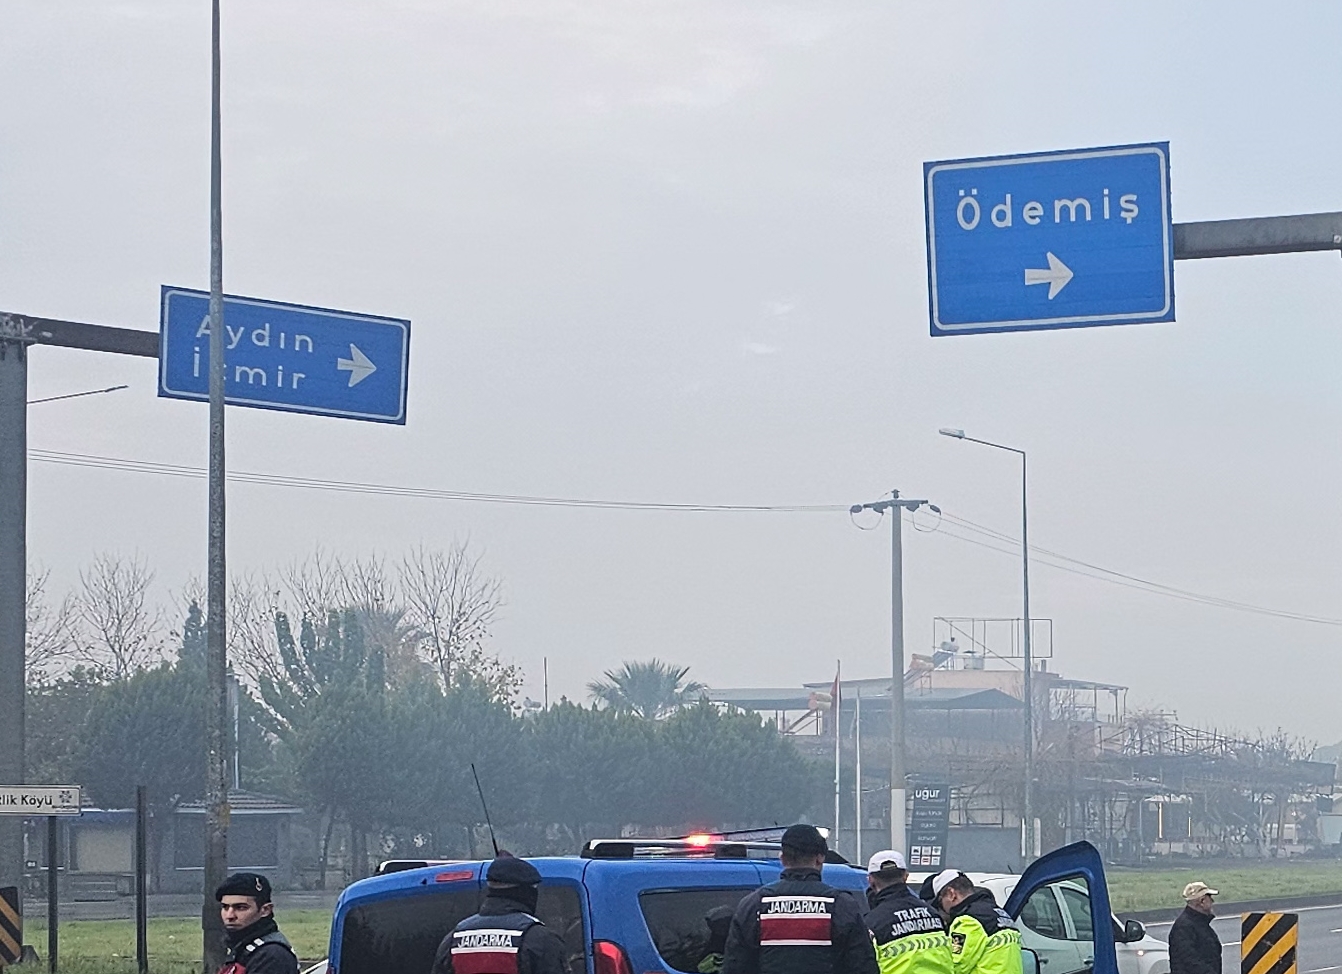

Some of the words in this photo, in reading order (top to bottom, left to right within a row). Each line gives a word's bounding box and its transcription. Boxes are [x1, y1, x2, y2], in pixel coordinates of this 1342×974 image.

[956, 188, 1140, 231] Ödemiş
[195, 314, 314, 353] Aydın
[192, 346, 307, 390] İmir
[21, 794, 53, 808] Köyü
[915, 787, 941, 801] uğur
[767, 900, 827, 914] JANDARMA
[457, 934, 513, 948] JANDARMA
